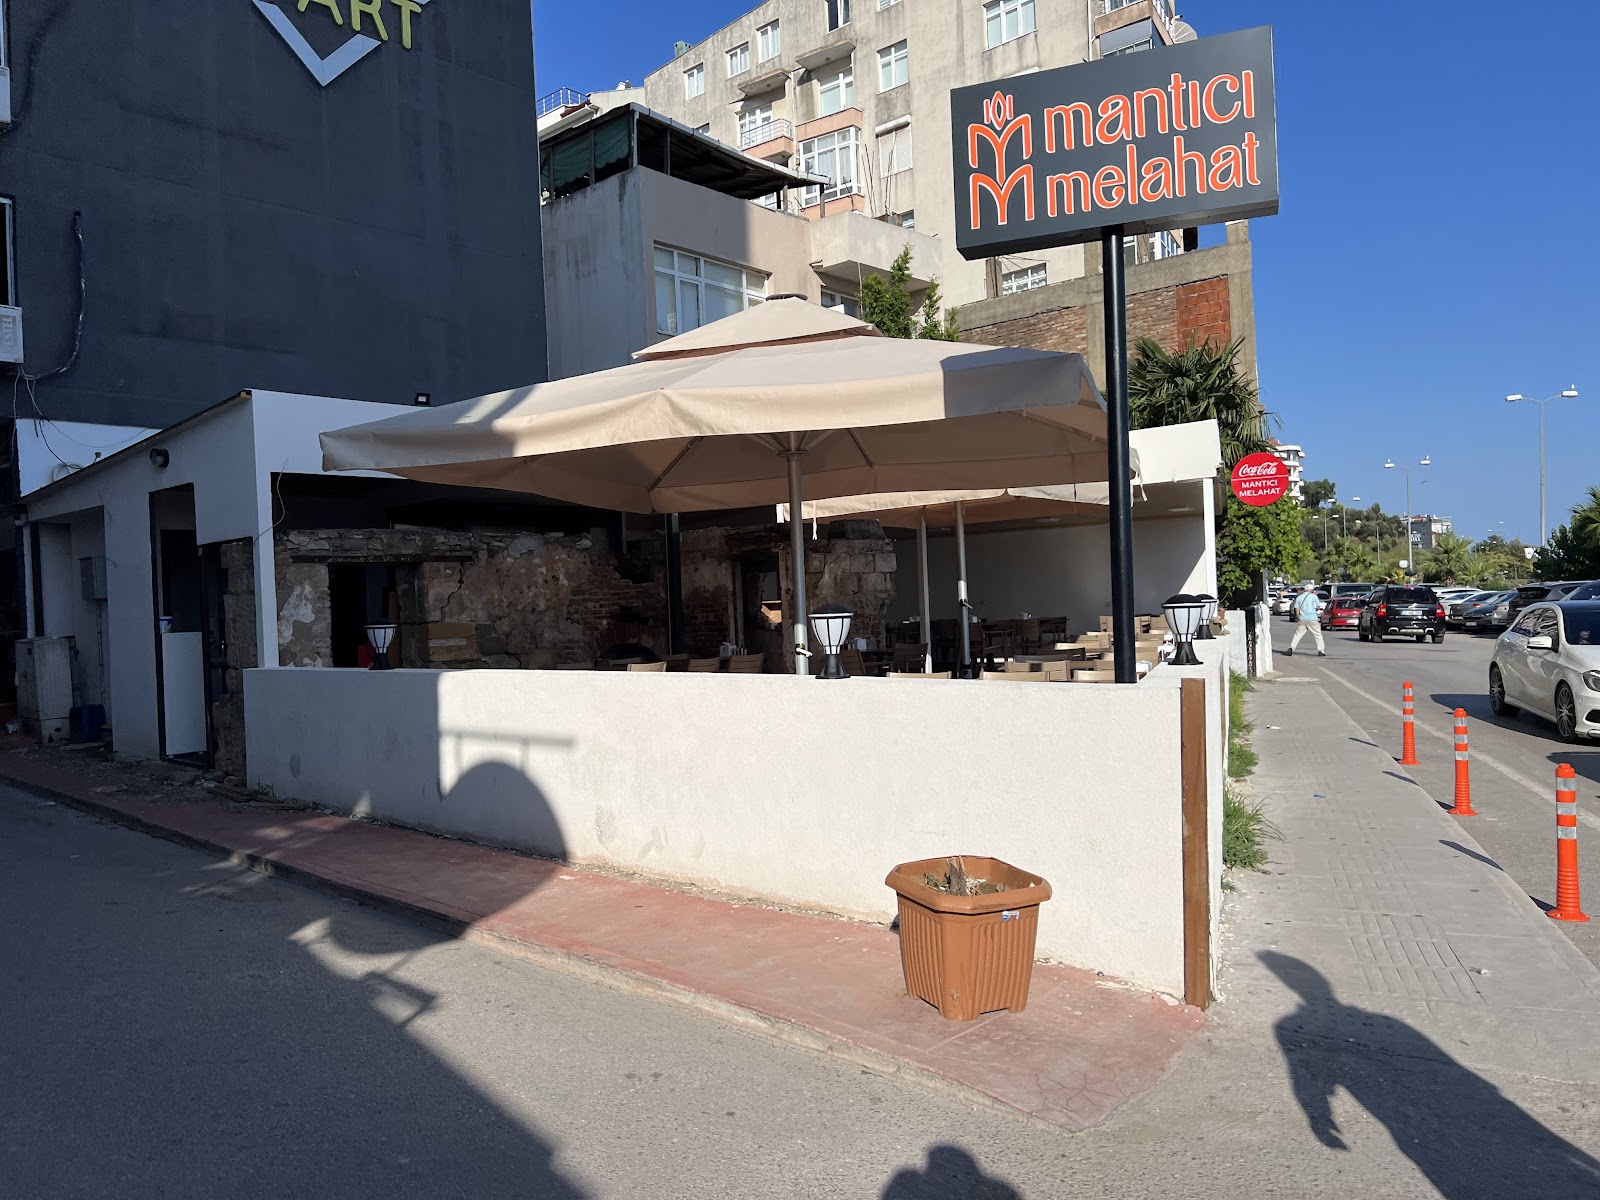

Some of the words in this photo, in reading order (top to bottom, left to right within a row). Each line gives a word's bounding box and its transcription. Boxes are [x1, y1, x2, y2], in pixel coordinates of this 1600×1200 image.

[1046, 131, 1261, 218] melahat
[1239, 461, 1279, 477] Coca-Cola
[1241, 479, 1278, 489] MANTICI
[1239, 487, 1281, 497] MELAHAT
